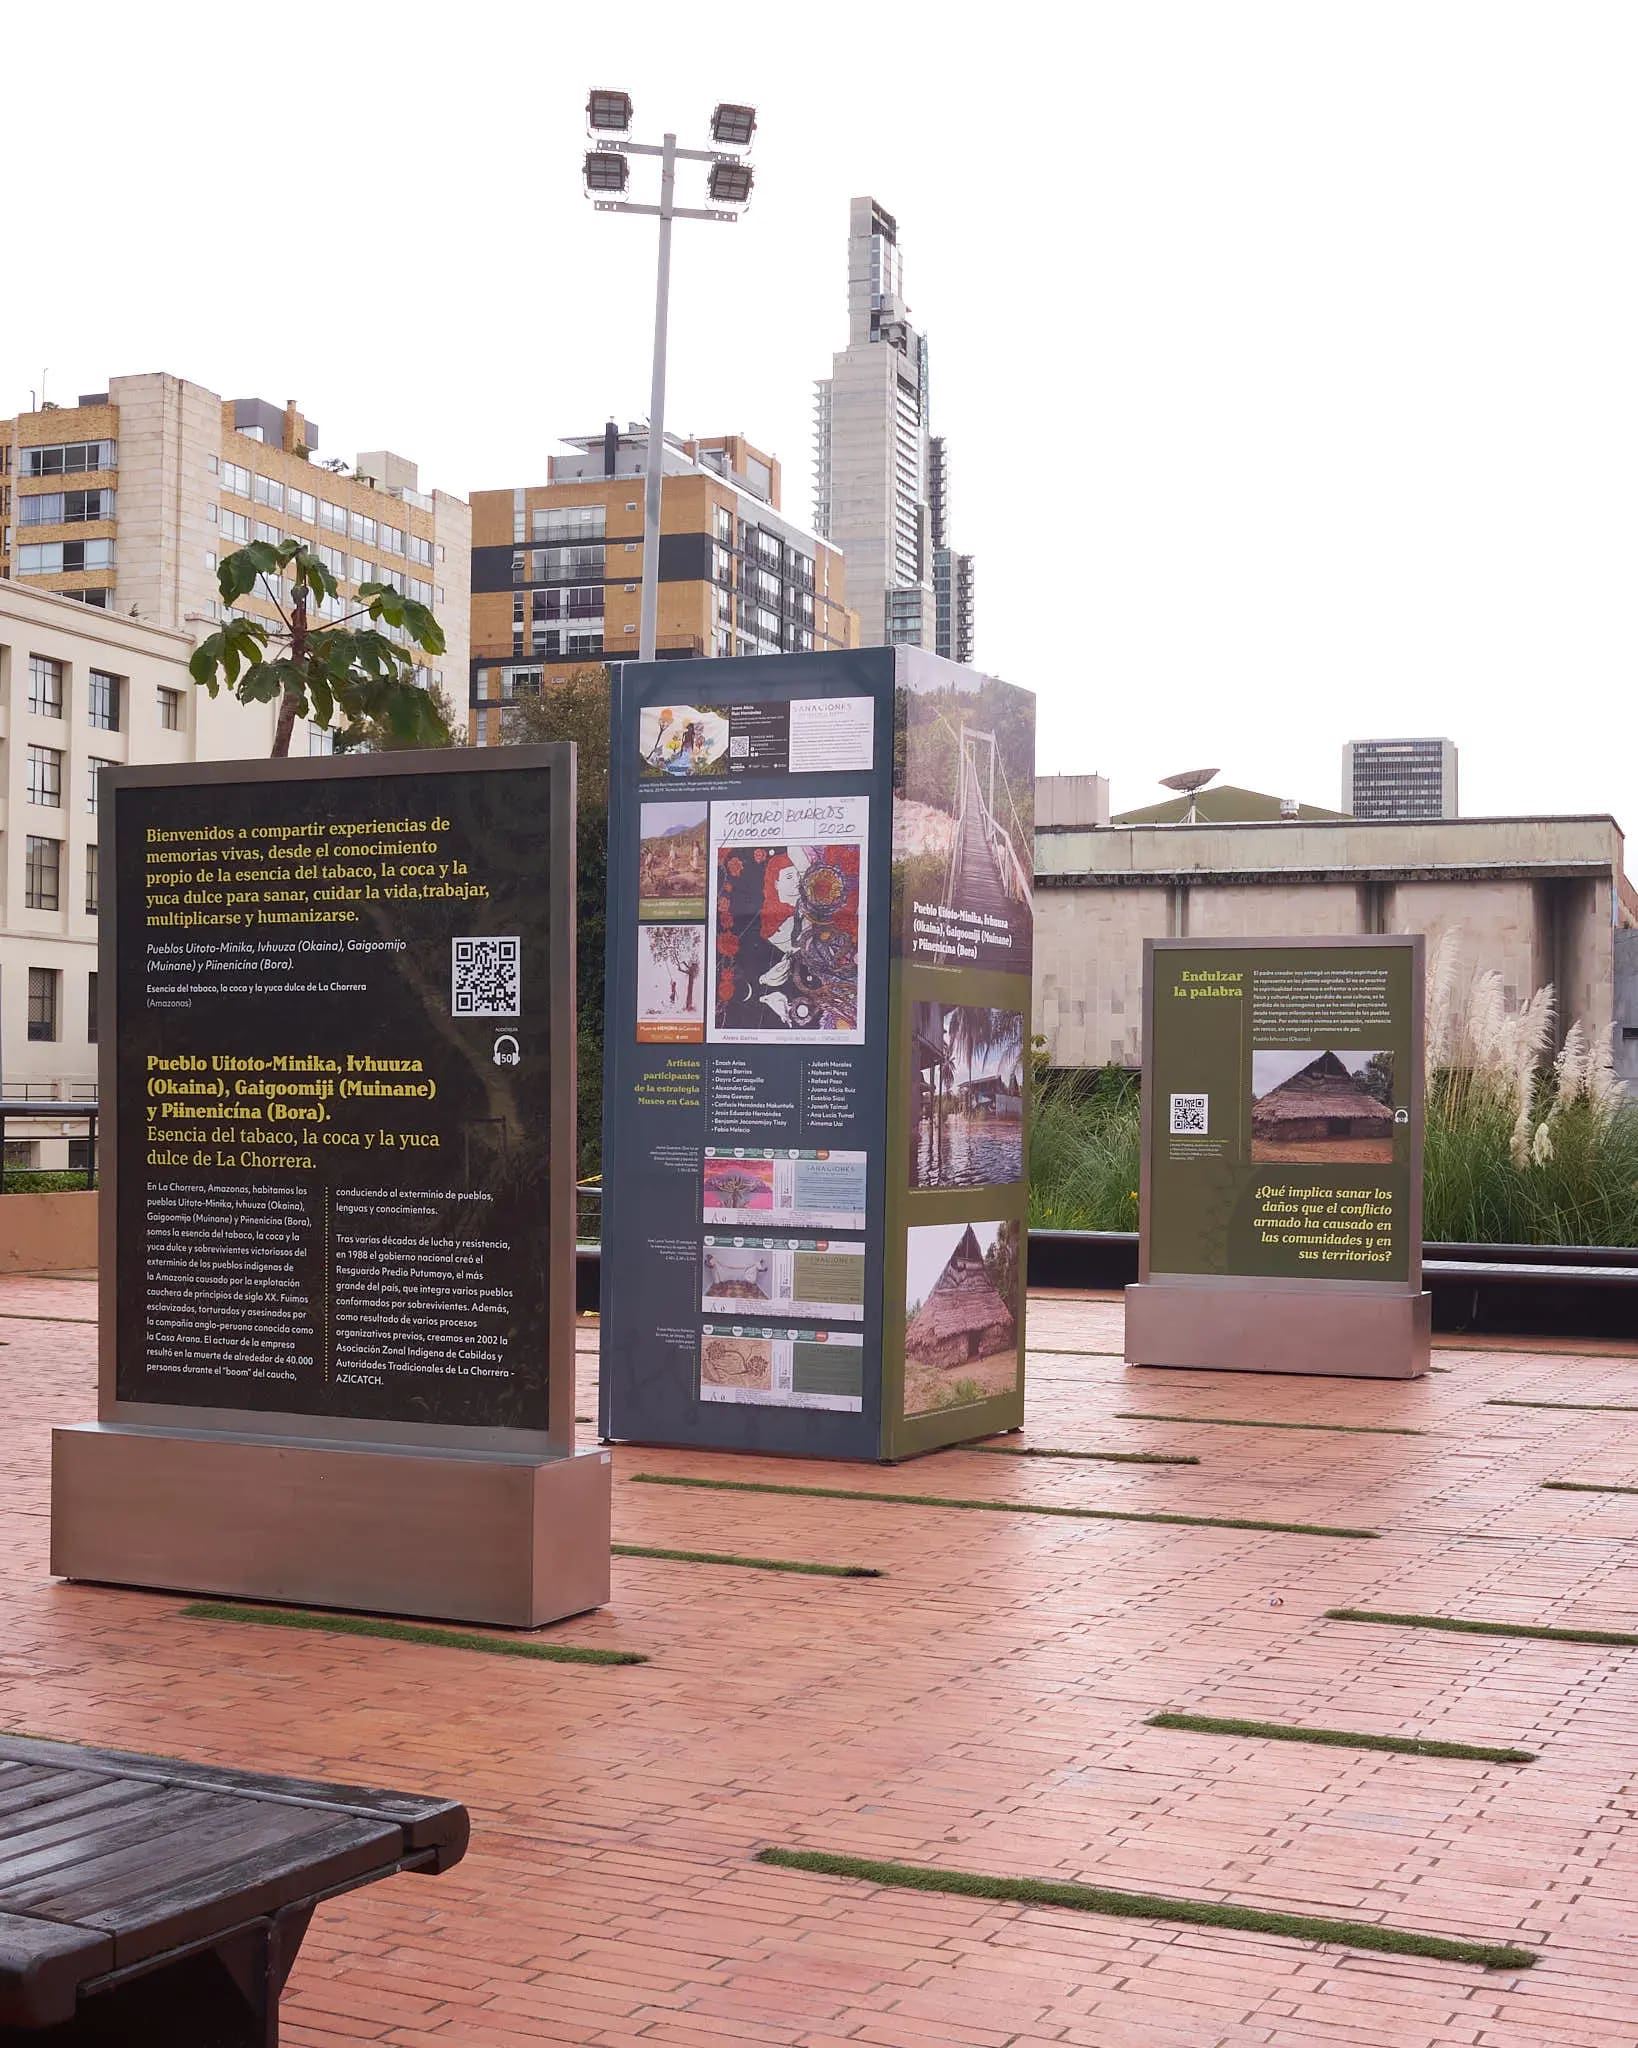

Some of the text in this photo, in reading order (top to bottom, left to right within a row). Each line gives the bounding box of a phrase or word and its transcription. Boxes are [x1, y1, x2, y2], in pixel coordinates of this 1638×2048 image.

[147, 816, 450, 842] Bienvenidos a compartir experiencias de
[819, 823, 856, 834] 2020
[147, 841, 437, 863] memorias vivas, desde el conocimiento
[146, 860, 468, 887] propio de la esencia del tabaco, la coca y la
[146, 882, 489, 909] yuca dulce para sanar, cuidar la vida,trabajar,
[146, 909, 359, 928] multiplicarse y humanizarse.
[147, 943, 183, 954] Pueblos
[298, 939, 344, 952] (Okaina),
[147, 960, 196, 972] (Muinane)
[197, 963, 204, 973] y
[260, 958, 294, 971] (Bora).
[1182, 971, 1243, 981] Endulzar
[147, 984, 176, 993] Esencia
[177, 984, 189, 992] del
[190, 984, 219, 993] tabaco,
[220, 983, 228, 992] la
[249, 986, 254, 994] y
[255, 983, 263, 992] la
[264, 985, 283, 994] yuca
[284, 982, 305, 991] dulce
[306, 982, 317, 991] de
[318, 982, 329, 991] La
[330, 982, 366, 991] Chorrera
[1174, 986, 1243, 999] la palabra
[147, 998, 192, 1008] (Amazonas)
[147, 1056, 207, 1071] Pueblo
[502, 1054, 512, 1063] 50
[644, 1072, 700, 1081] participantes
[147, 1079, 230, 1097] (Okaina),
[339, 1080, 436, 1099] (Muinane)
[657, 1086, 700, 1094] estrategia
[146, 1106, 157, 1122] y
[267, 1103, 331, 1122] (Bora).
[147, 1126, 440, 1150] Esencia del tabaco, la coca y la yuca
[147, 1150, 316, 1168] dulce de La Chorrera.
[147, 1182, 308, 1195] En La Chorrera, Amazonas, habitamos los
[336, 1188, 388, 1197] conduciendo
[390, 1188, 398, 1198] al
[399, 1190, 444, 1199] exterminio
[445, 1190, 456, 1199] de
[1255, 1185, 1392, 1200] ¿Qué implica sanar los
[336, 1203, 368, 1214] lenguas
[369, 1206, 375, 1215] y
[1262, 1201, 1392, 1217] daños que el conflicto
[1253, 1217, 1392, 1230] armado ha causado en
[336, 1234, 510, 1250] Tras varias décadas de lucha y resistencia,
[1261, 1231, 1279, 1242] las
[1282, 1234, 1362, 1245] comunidades
[1365, 1238, 1373, 1248] y
[1298, 1250, 1392, 1261] sus territorios?
[336, 1374, 384, 1385] AZICATCH.
